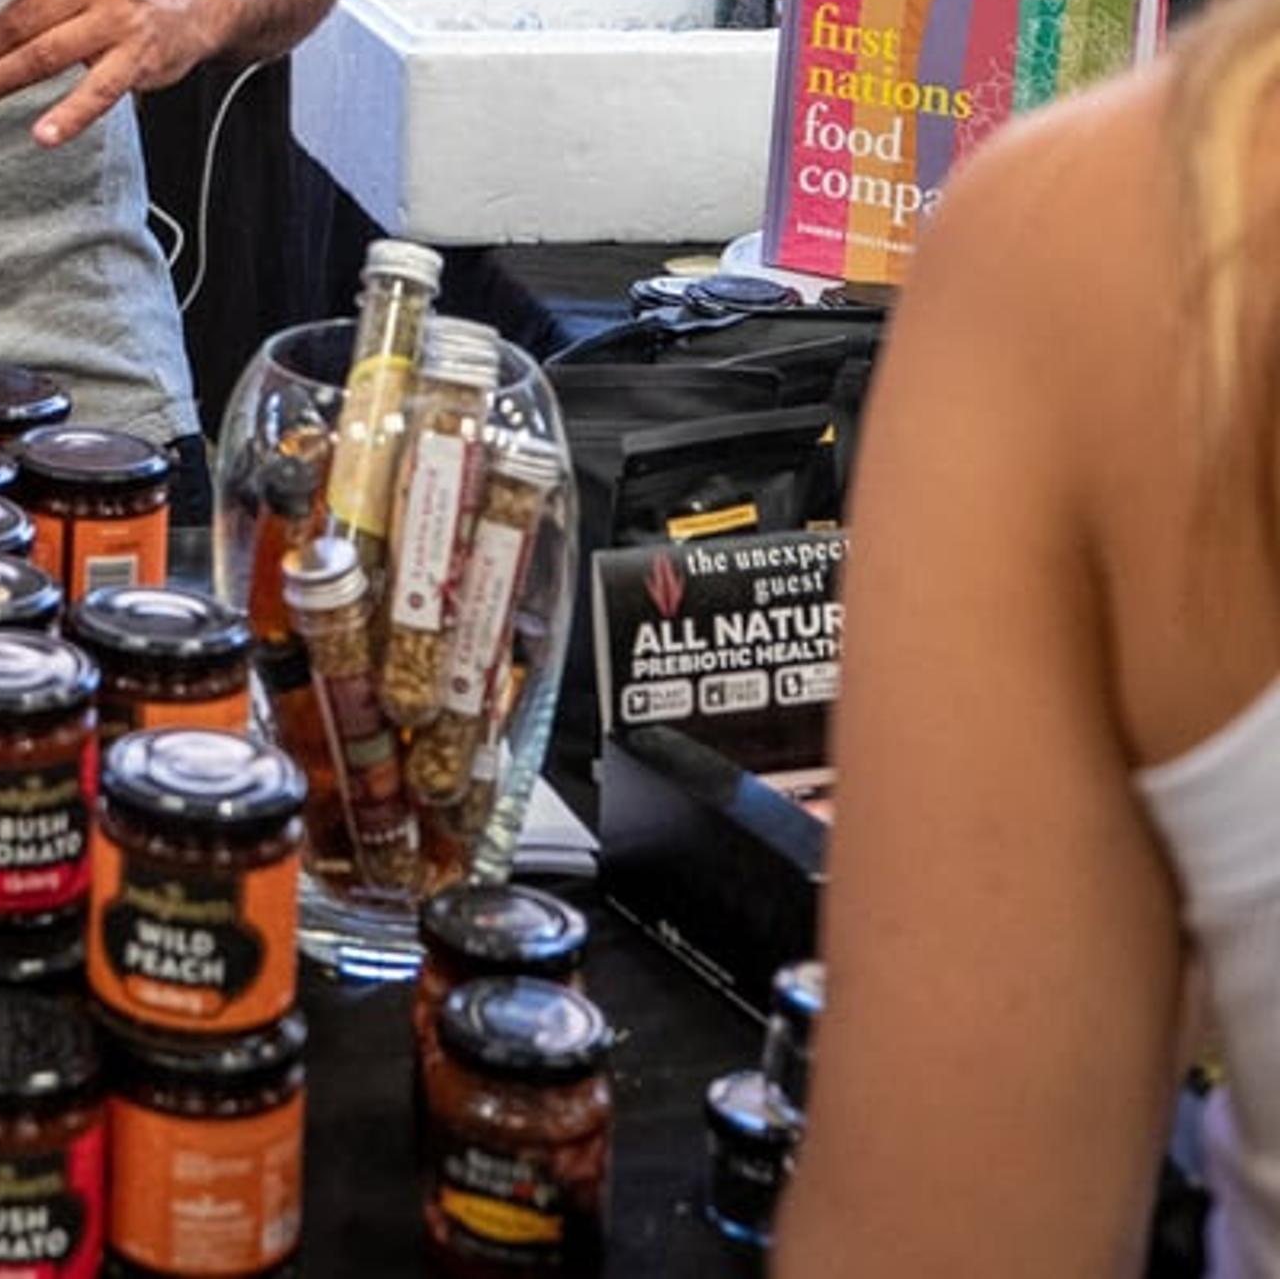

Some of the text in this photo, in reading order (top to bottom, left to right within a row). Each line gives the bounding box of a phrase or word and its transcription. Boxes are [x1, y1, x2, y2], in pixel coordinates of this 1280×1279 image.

[811, 5, 899, 58] first
[806, 64, 973, 119] nations
[803, 104, 903, 163] food
[798, 162, 944, 226] compa
[687, 540, 851, 575] the unexpec
[753, 571, 824, 605] guest
[633, 603, 846, 657] ALL NATUR
[632, 647, 753, 679] PREBIOTIC
[137, 920, 215, 957] WILD
[125, 941, 226, 985] PEACH
